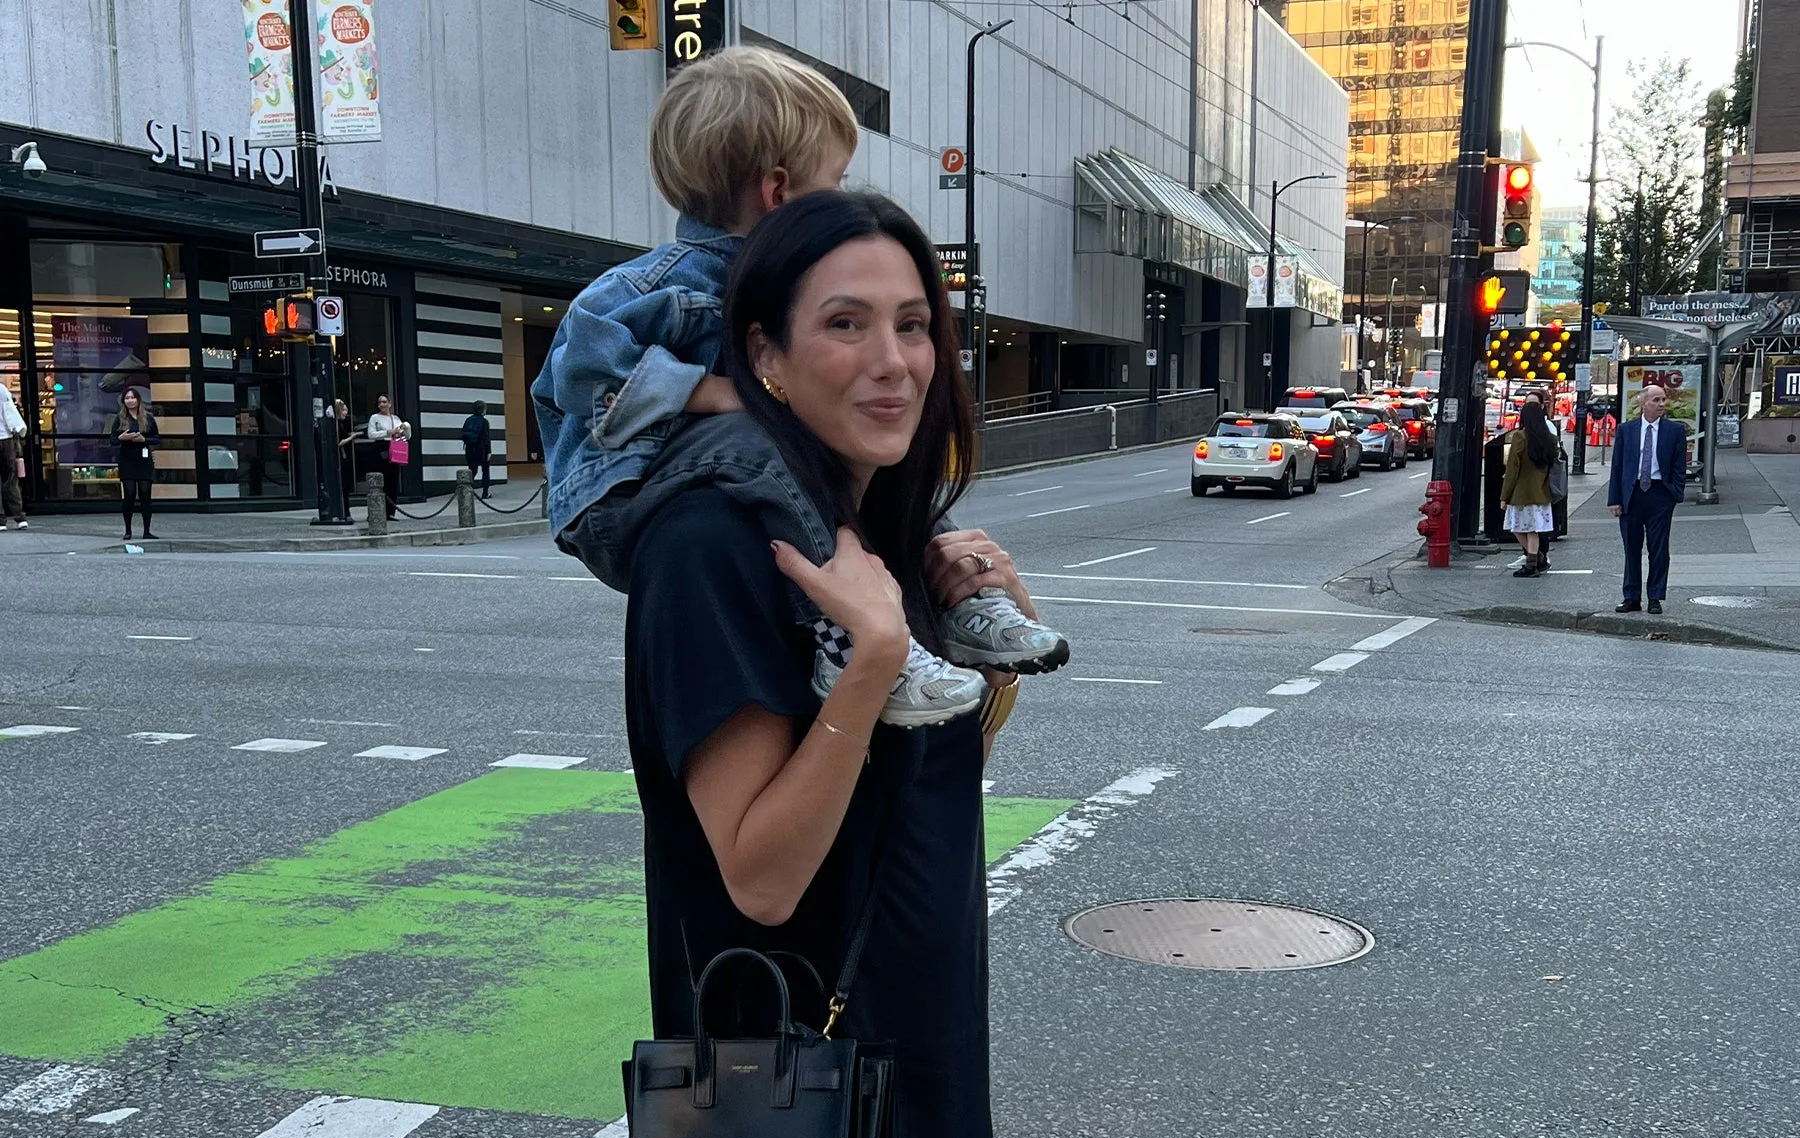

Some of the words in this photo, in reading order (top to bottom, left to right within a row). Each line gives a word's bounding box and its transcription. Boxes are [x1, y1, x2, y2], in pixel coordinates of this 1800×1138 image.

[332, 17, 363, 30] FARMERS
[258, 24, 287, 37] FARMERS
[336, 29, 366, 40] MARKETS
[262, 35, 291, 47] MARKETS
[936, 250, 967, 260] PARKIN
[327, 265, 388, 288] SEPHORA
[231, 277, 274, 291] Dunsmuir
[1649, 300, 1689, 311] Pardon
[1692, 300, 1710, 310] the
[1711, 300, 1749, 309] mess...
[1686, 311, 1759, 323] nonetheless?
[60, 322, 81, 333] The
[83, 322, 112, 333] Matte
[61, 333, 124, 344] Renaissance
[1642, 370, 1684, 389] BIG
[964, 614, 991, 634] N
